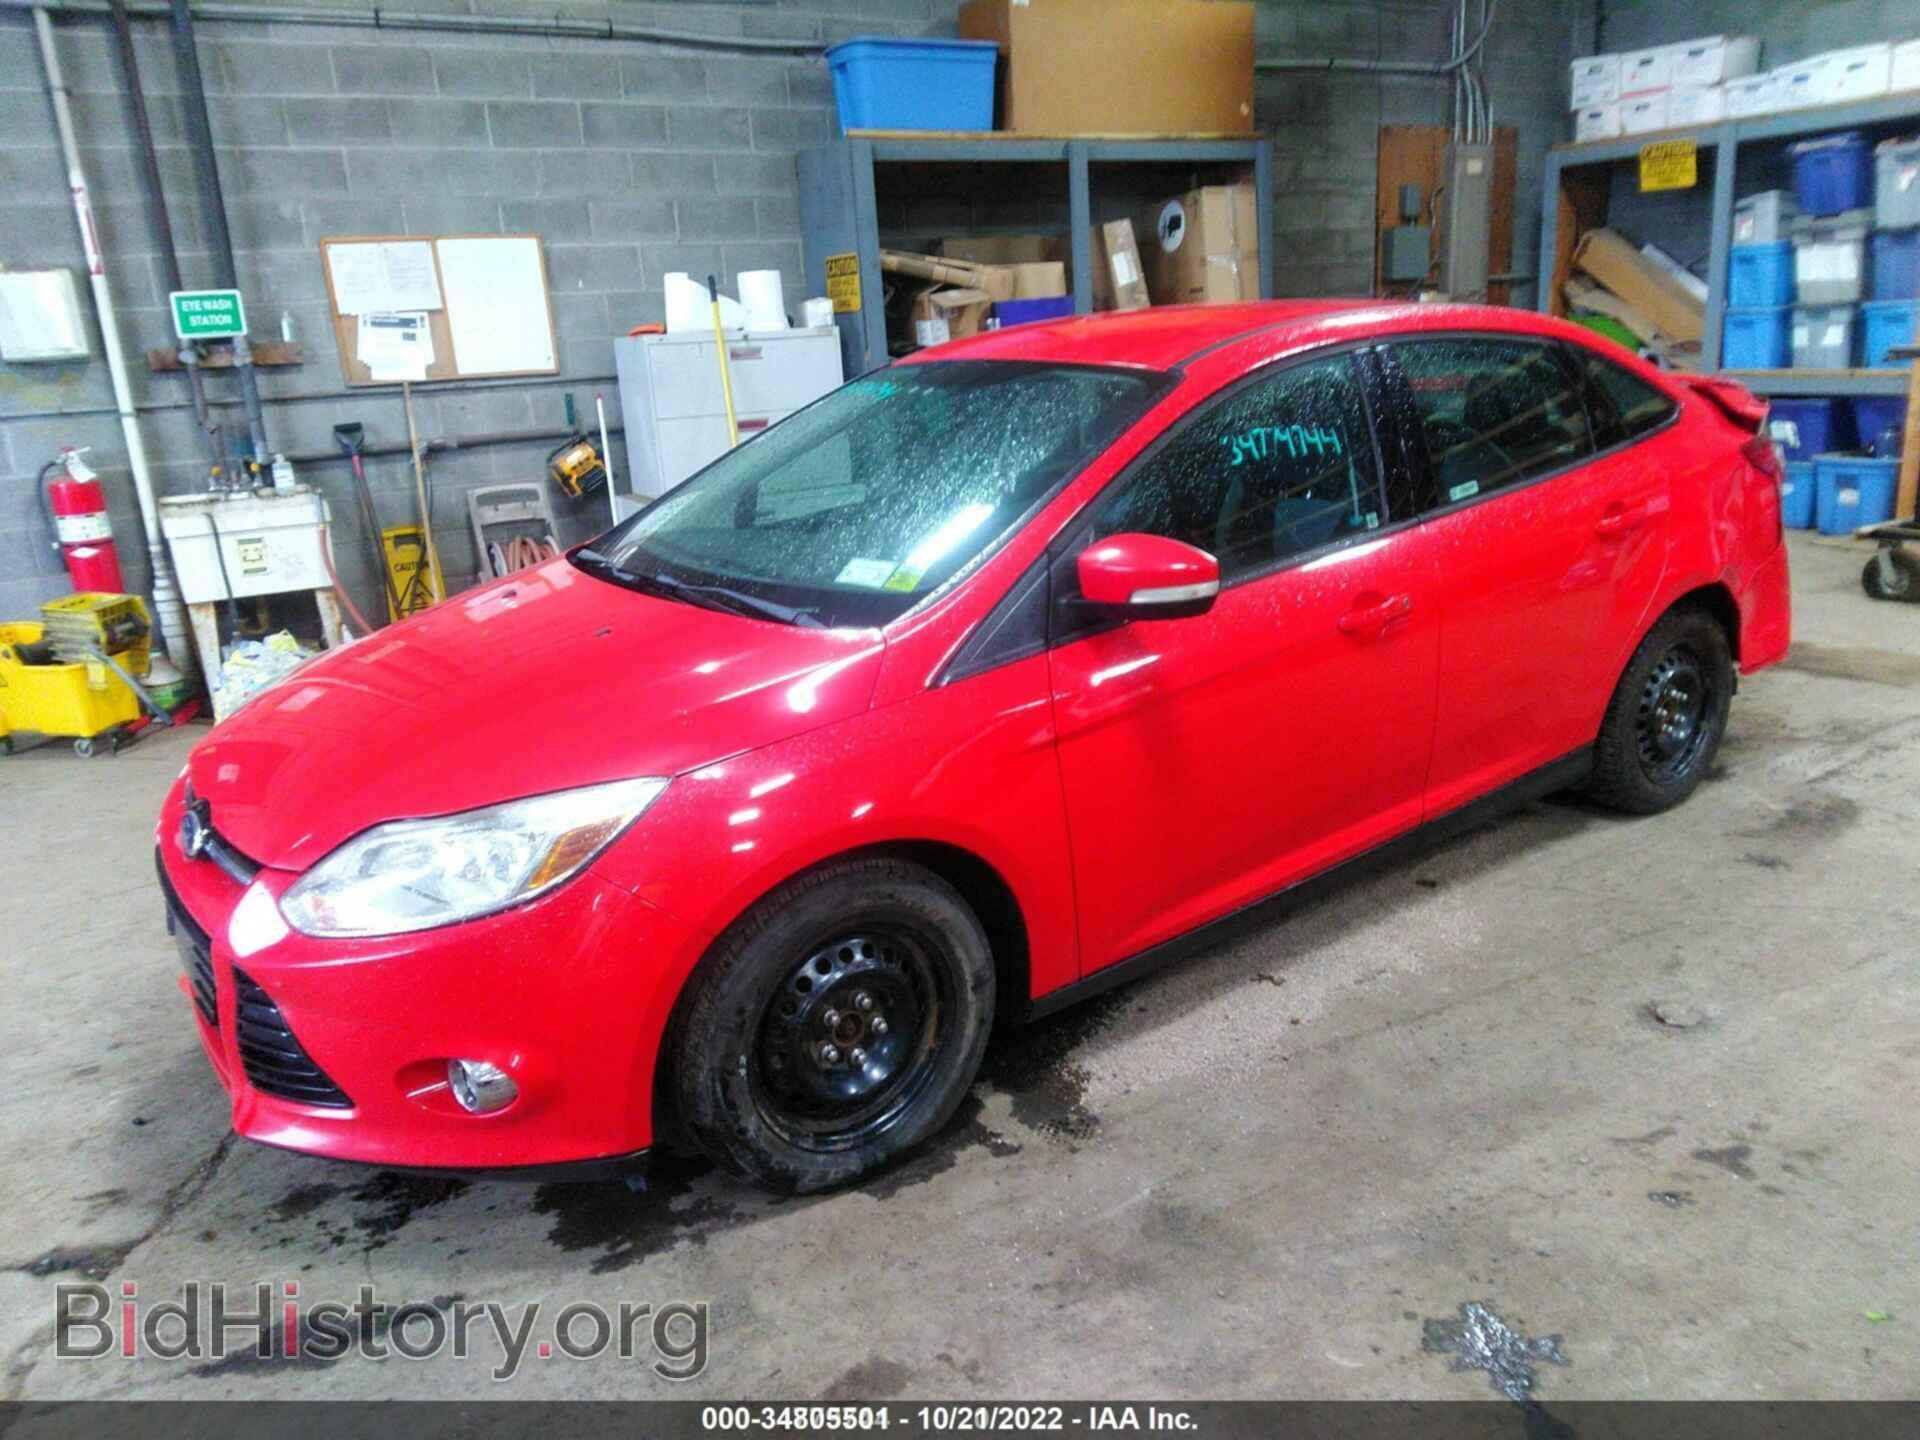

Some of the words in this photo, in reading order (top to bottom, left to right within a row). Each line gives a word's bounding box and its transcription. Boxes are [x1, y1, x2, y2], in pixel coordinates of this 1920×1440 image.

[181, 300, 202, 312] EYE
[203, 299, 232, 310] WASH
[189, 314, 232, 327] STATION
[393, 560, 431, 573] CAUTN
